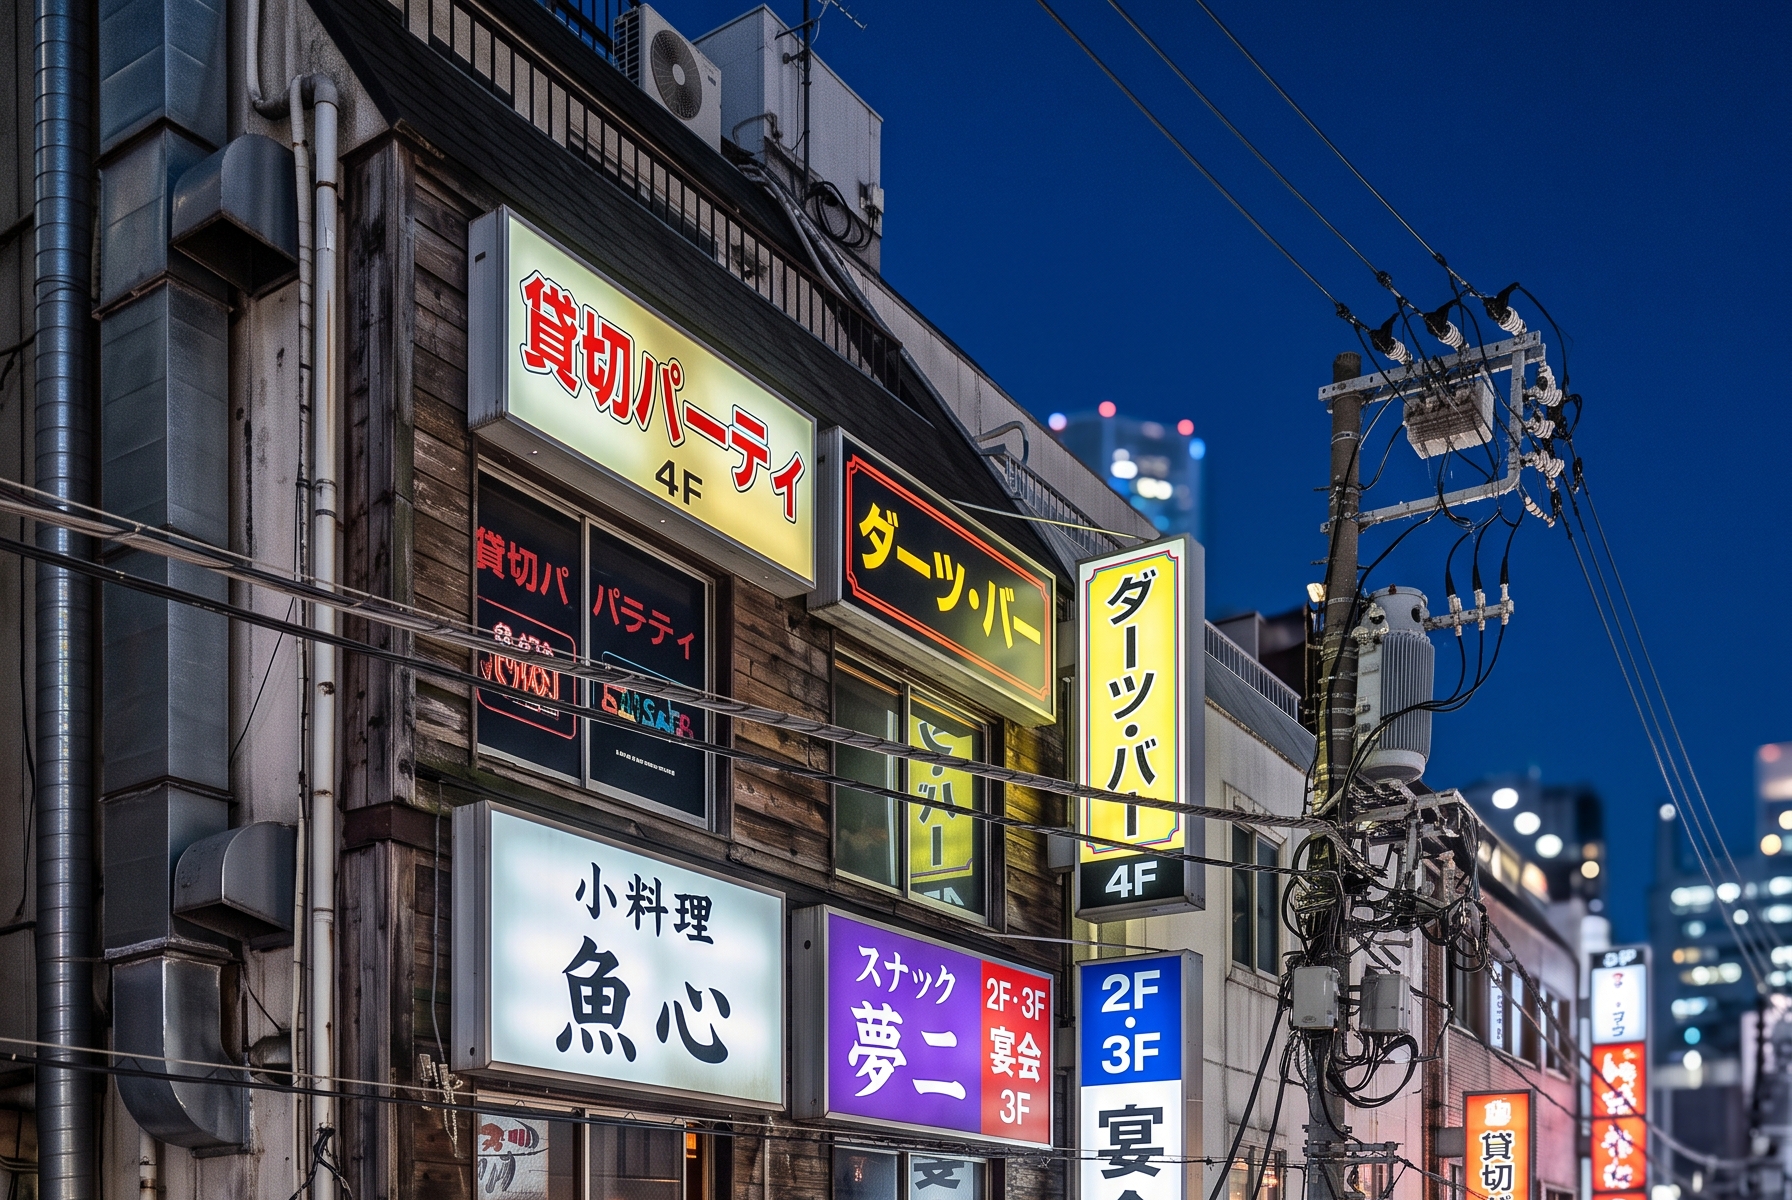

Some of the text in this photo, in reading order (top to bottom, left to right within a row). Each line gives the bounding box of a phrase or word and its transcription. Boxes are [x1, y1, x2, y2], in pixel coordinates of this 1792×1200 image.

[520, 270, 804, 524] 貸切パーティ
[655, 459, 703, 505] 4F
[859, 502, 1041, 649] ダーツ・バー
[592, 584, 695, 660] パラティ
[1107, 569, 1157, 837] ダーツ・バー
[575, 861, 714, 945] 小料理
[1105, 861, 1159, 899] 4F
[556, 935, 731, 1064] 魚心
[856, 945, 956, 1005] スナック
[986, 977, 1046, 1021] 2F・3F
[848, 1000, 967, 1101] 夢二
[990, 1026, 1042, 1083] 宴会
[1102, 1032, 1161, 1074] 3F
[999, 1089, 1031, 1125] 3F
